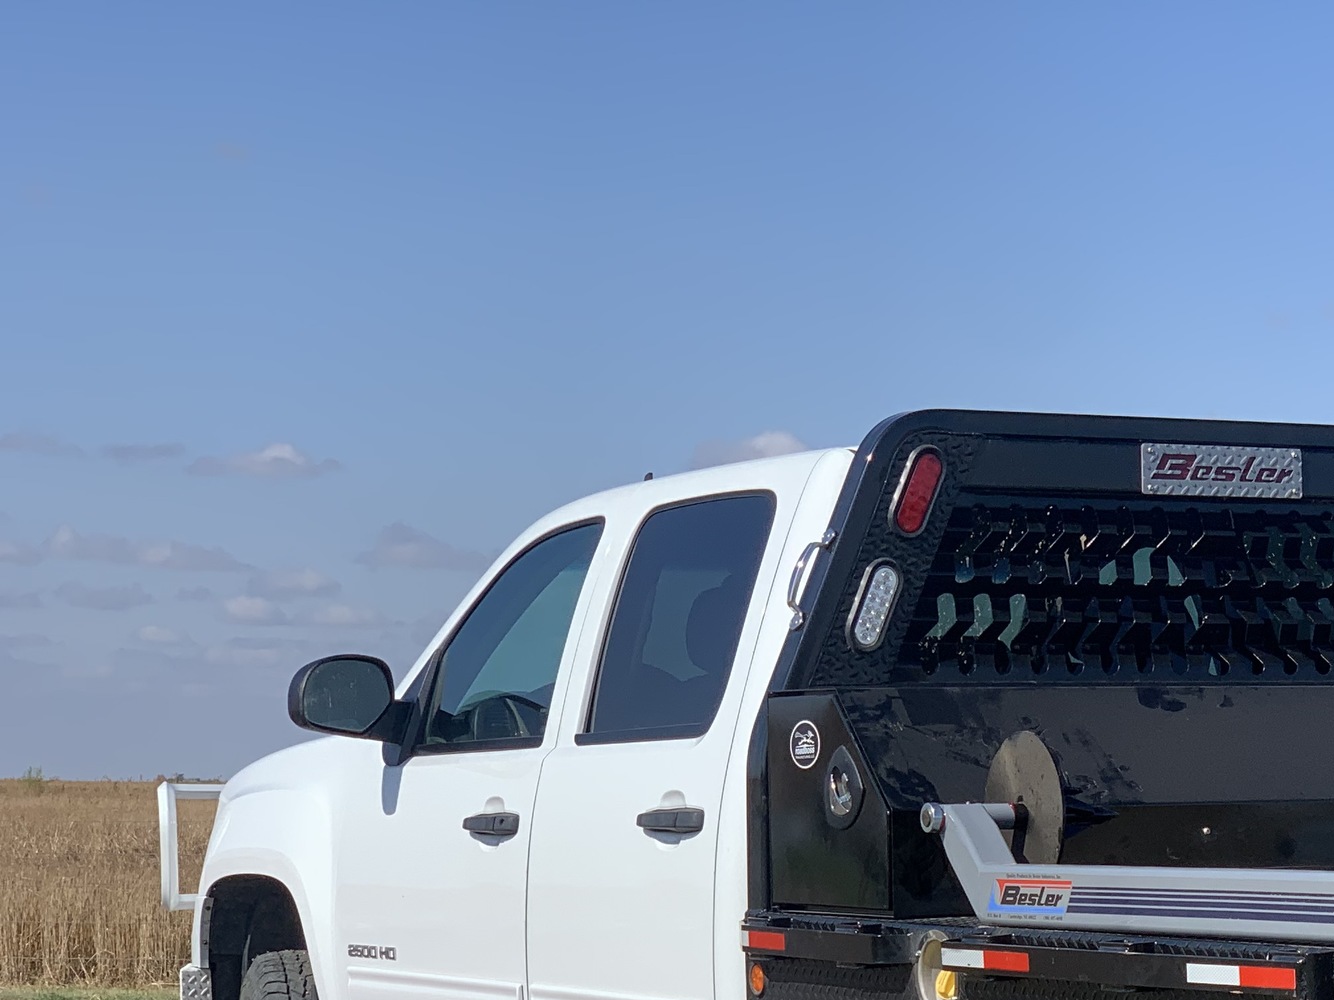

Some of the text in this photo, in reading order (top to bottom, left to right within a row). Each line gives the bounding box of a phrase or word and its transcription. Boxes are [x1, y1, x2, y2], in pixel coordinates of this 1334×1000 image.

[1150, 453, 1294, 484] Besler
[1000, 885, 1063, 907] Besler
[347, 944, 396, 961] 2500 HD
